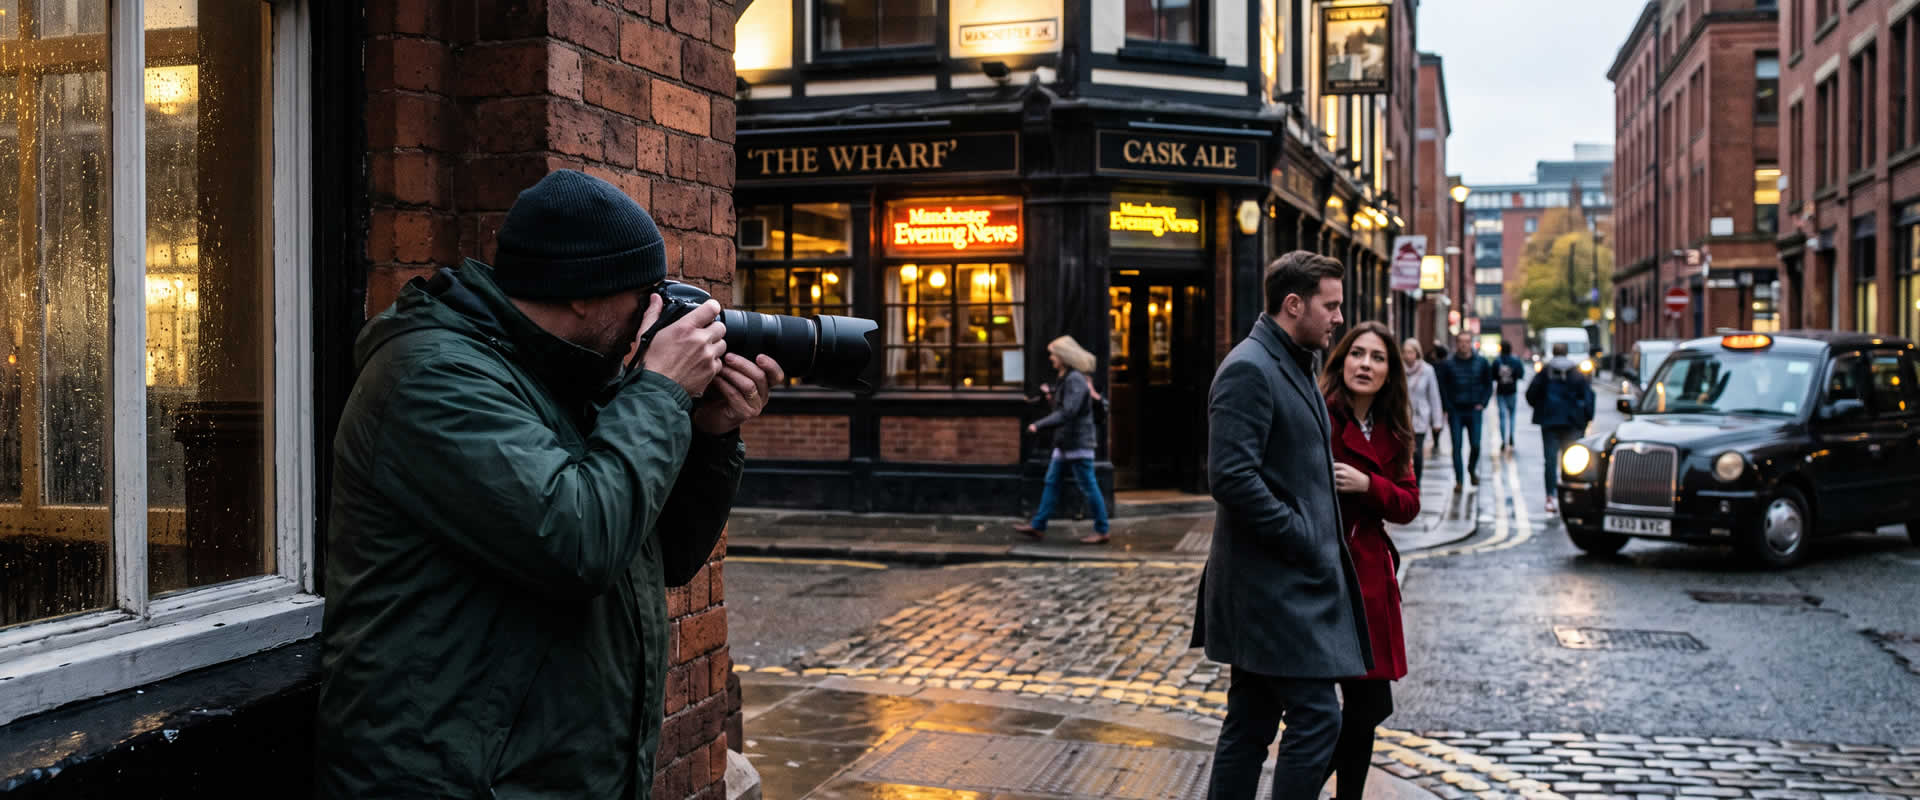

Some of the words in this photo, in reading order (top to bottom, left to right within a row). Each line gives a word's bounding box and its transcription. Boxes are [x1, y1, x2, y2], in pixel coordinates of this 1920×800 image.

[964, 26, 1031, 41] MANER
[747, 147, 819, 175] ‘THE
[827, 139, 957, 172] WHARF’
[1123, 139, 1187, 166] CASK
[1192, 145, 1238, 169] ALE
[908, 206, 991, 225] Manchester
[1109, 211, 1165, 237] Evening
[1163, 214, 1199, 233] News
[894, 222, 967, 250] Evening
[967, 222, 1018, 243] News
